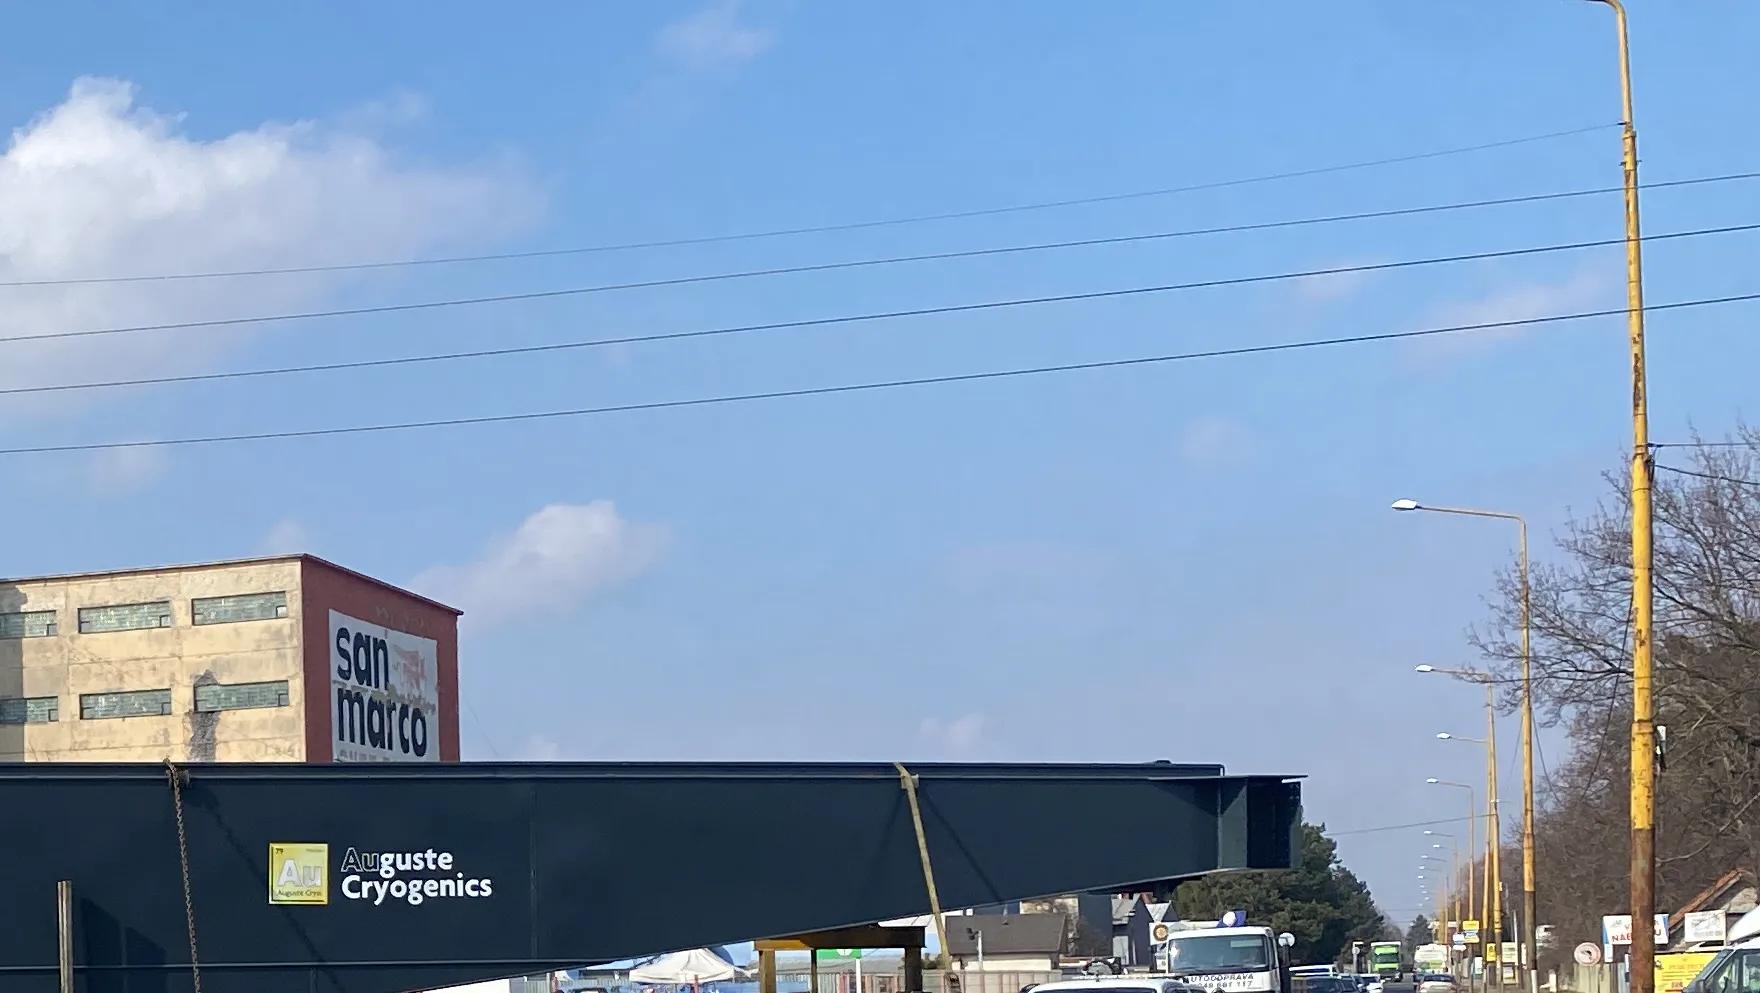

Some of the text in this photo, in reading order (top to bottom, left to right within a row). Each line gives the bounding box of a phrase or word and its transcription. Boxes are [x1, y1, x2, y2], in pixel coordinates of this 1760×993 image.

[336, 627, 389, 690] san
[337, 687, 427, 757] marco
[277, 859, 323, 887] Au
[340, 847, 453, 878] Auguste
[341, 872, 492, 906] Cryogenics
[1183, 973, 1254, 983] UTODOPRAVA
